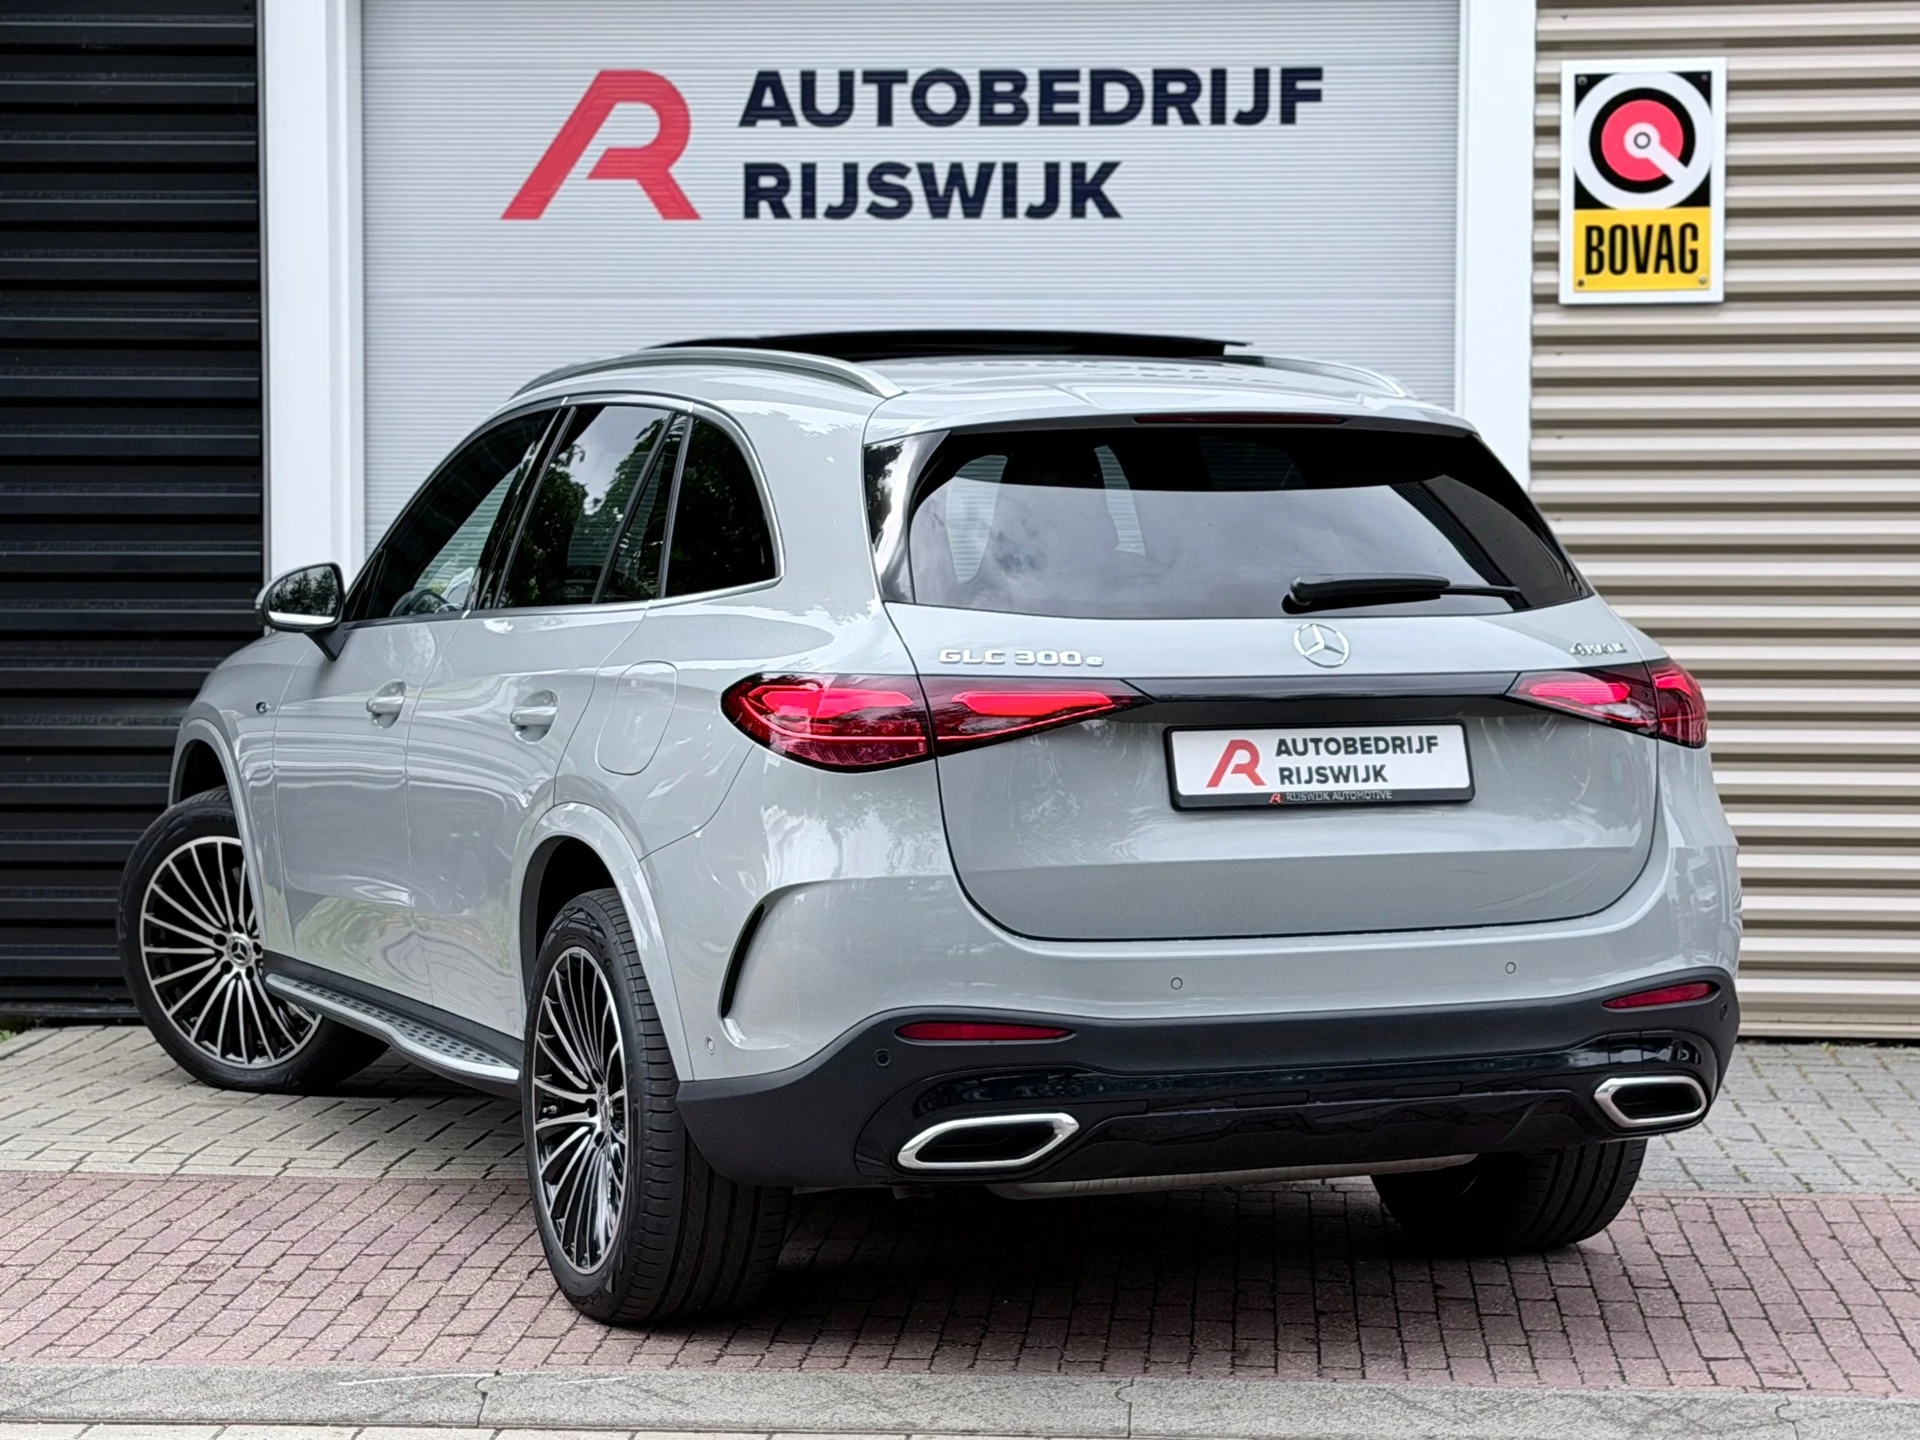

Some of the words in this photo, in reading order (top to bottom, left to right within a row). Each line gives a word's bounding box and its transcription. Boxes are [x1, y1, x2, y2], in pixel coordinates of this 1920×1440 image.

[739, 66, 1324, 127] AUTOBEDRIJF
[742, 161, 1123, 220] RIJSWIJK
[1585, 222, 1699, 275] BOVAG
[939, 649, 1006, 665] GLC
[1275, 735, 1439, 757] AUTOBEDRIJF
[1278, 764, 1389, 785] RIJSWIJK
[1286, 791, 1330, 801] RIJSWIJK
[1332, 790, 1393, 801] AUTOMOTIVE
